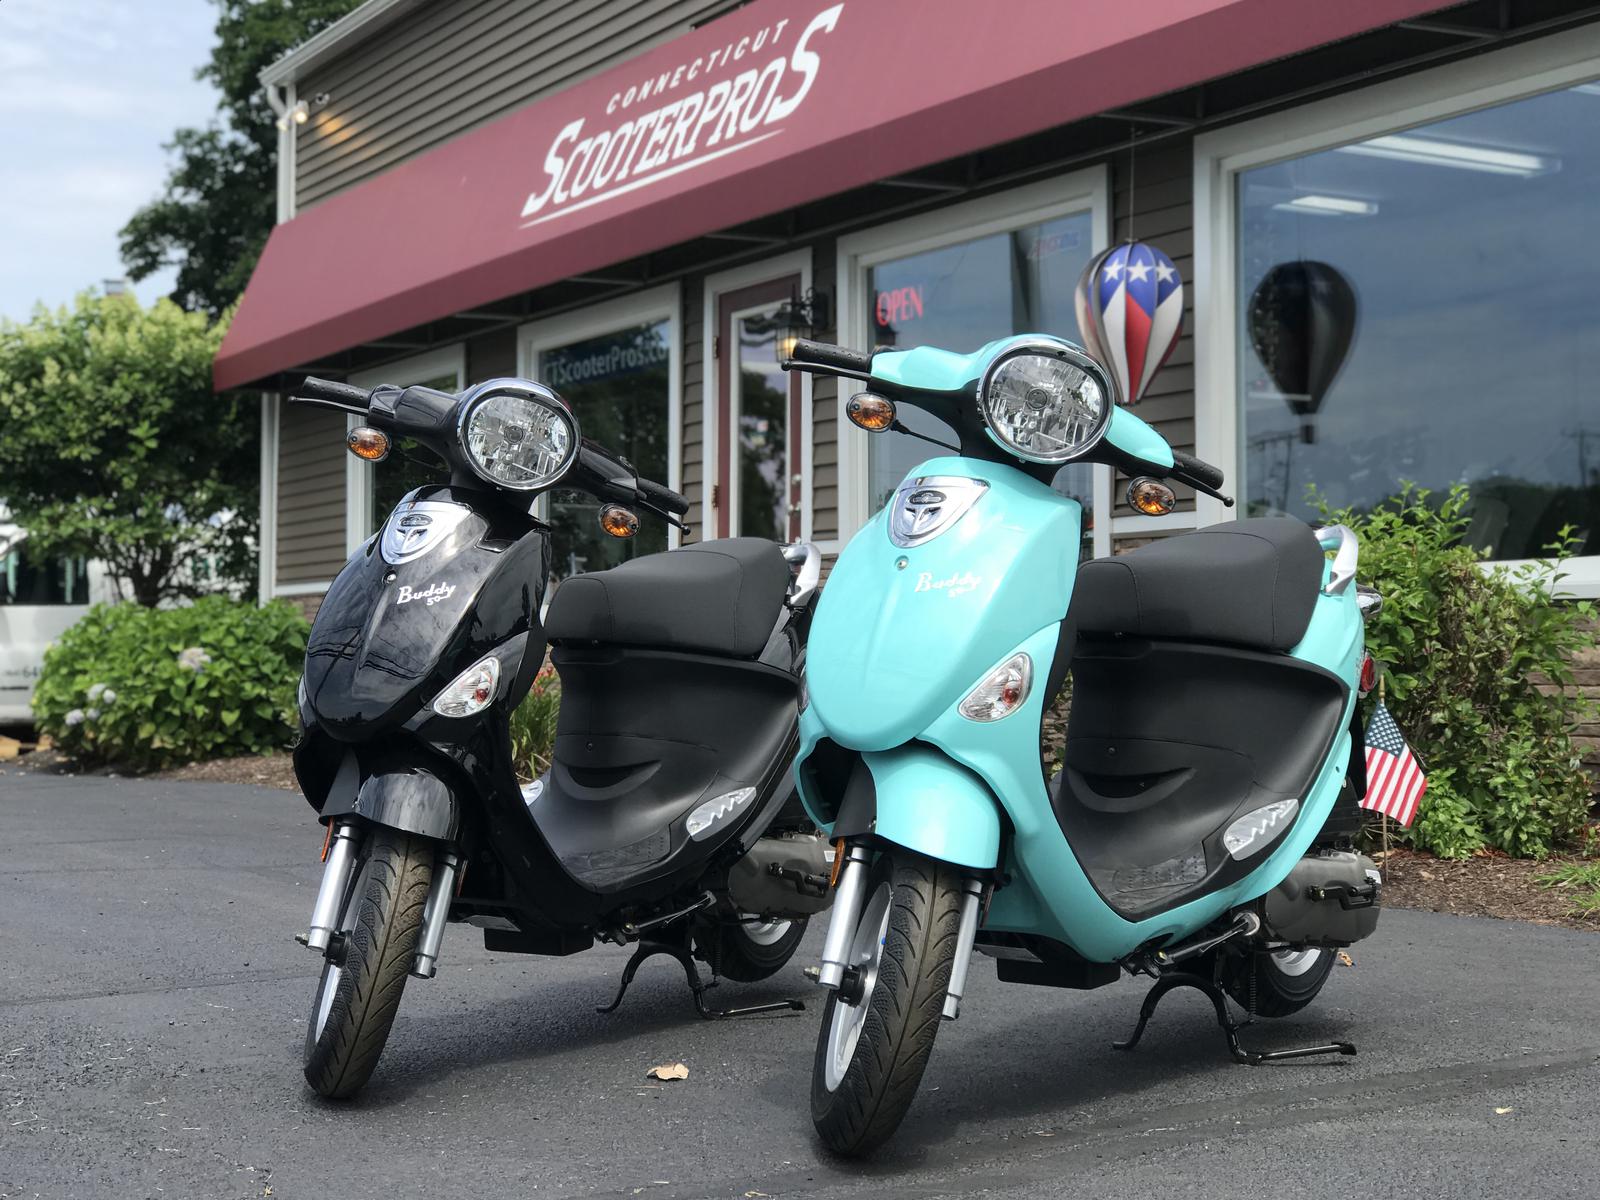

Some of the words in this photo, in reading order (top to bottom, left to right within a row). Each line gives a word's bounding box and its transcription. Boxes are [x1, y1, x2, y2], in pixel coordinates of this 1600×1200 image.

[606, 19, 788, 114] CONNECTICUT
[876, 286, 923, 326] OPEN
[397, 582, 456, 604] Buddy
[914, 572, 981, 593] Buddy
